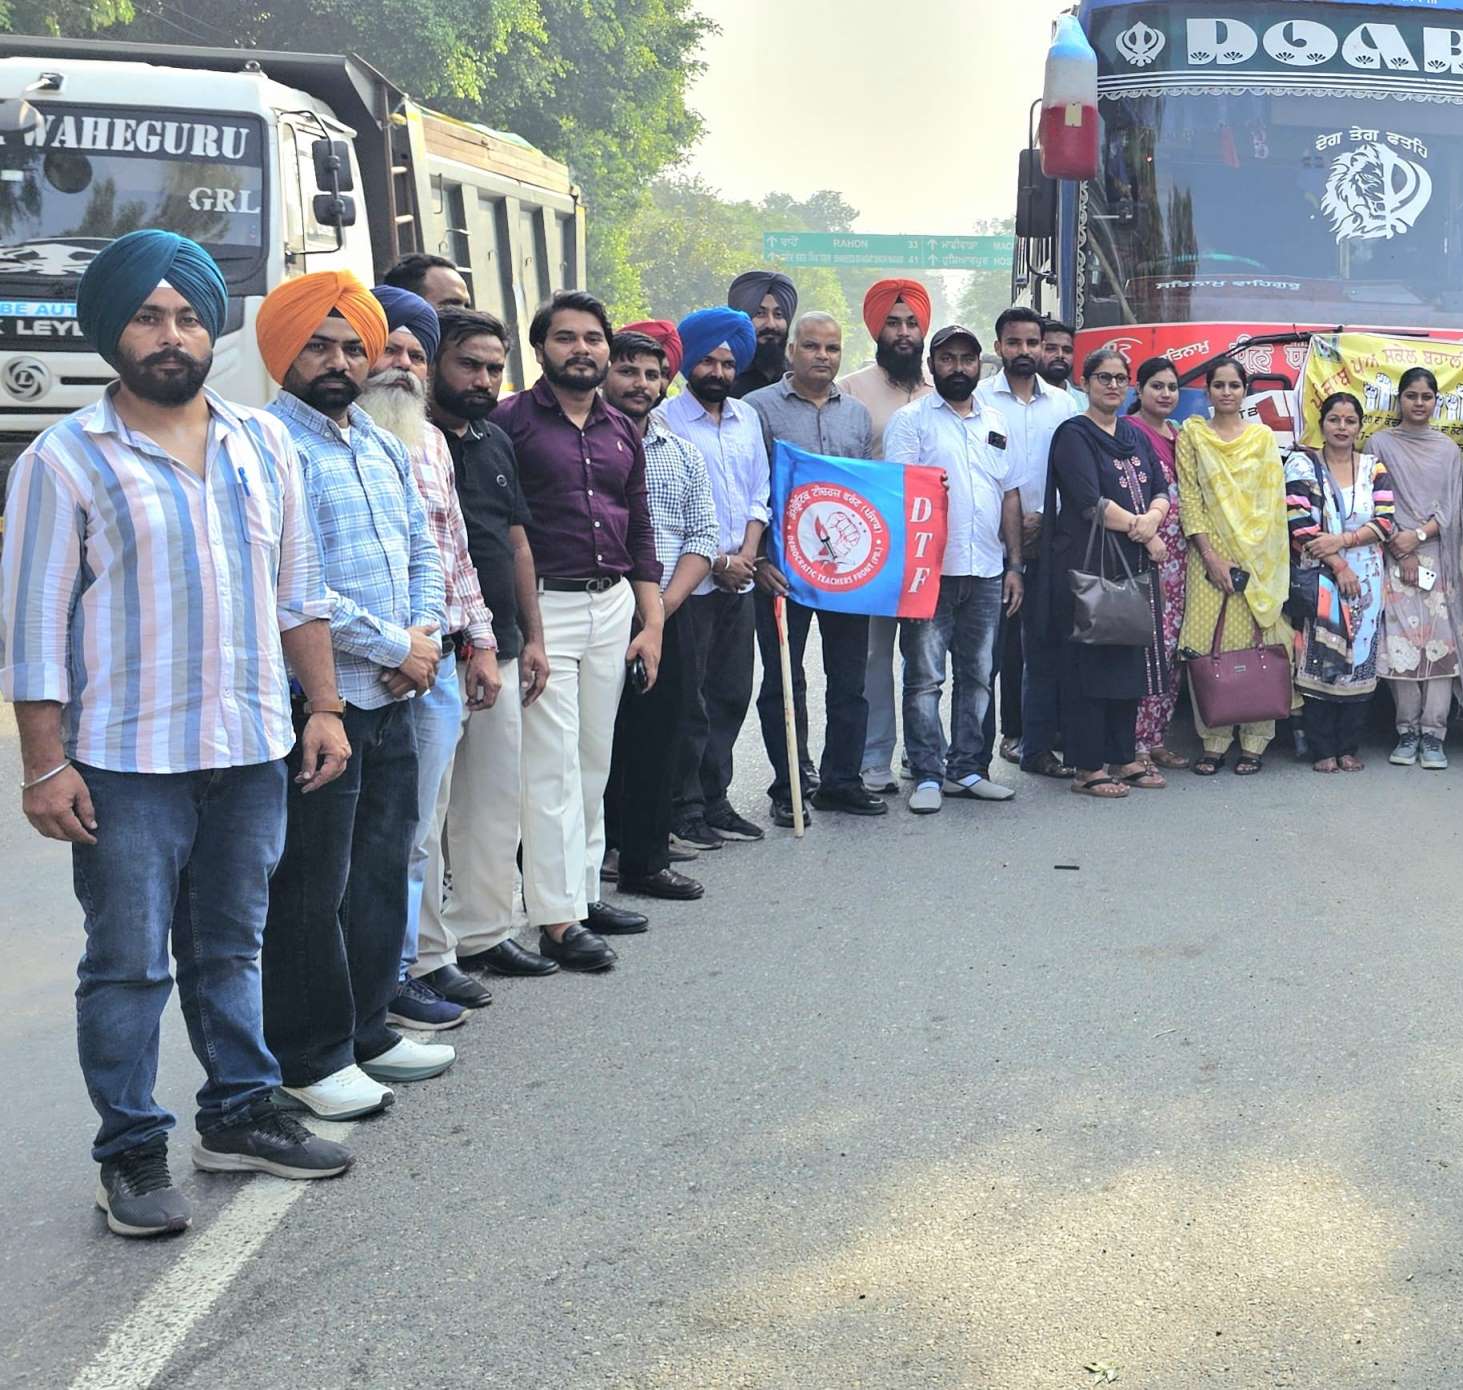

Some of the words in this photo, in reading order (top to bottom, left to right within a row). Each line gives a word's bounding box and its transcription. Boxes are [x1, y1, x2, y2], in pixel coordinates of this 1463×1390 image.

[1315, 131, 1343, 151] ਦੇਗ
[1349, 125, 1379, 141] ਤੇਗ
[188, 188, 260, 214] GRL
[833, 239, 868, 248] RAHON
[787, 535, 817, 578] DEMOCRATIC
[817, 574, 853, 586] TEACHERS
[853, 562, 874, 580] FRONT
